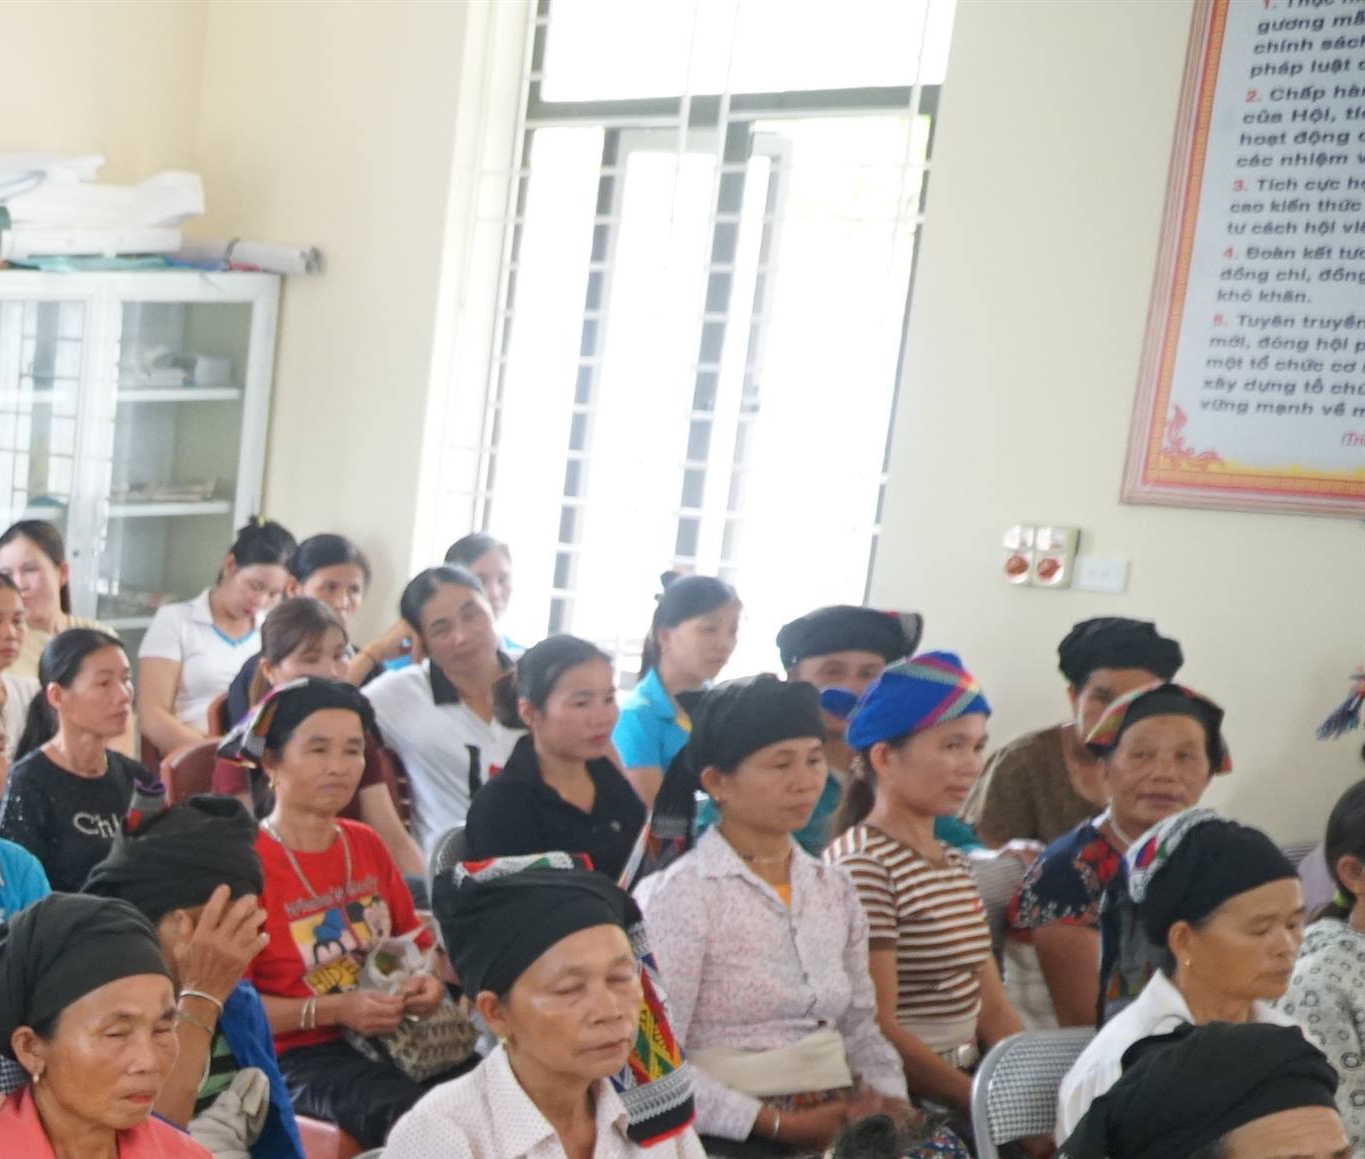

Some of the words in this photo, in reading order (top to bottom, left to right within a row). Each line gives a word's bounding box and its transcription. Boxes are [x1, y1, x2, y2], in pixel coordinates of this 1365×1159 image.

[1257, 18, 1325, 35] gương
[1254, 38, 1313, 54] chính
[1250, 61, 1303, 79] pháp
[1311, 58, 1350, 74] luật
[1245, 89, 1262, 103] 2.
[1270, 85, 1325, 102] Chấp
[1243, 109, 1283, 125] của
[1239, 131, 1286, 147] hoạt
[1293, 130, 1350, 147] động
[1236, 153, 1274, 168] các
[1280, 151, 1349, 168] nhiệm
[1232, 179, 1248, 193] 3.
[1257, 178, 1298, 192] Tích
[1304, 178, 1341, 193] cực
[1230, 201, 1265, 214] cao
[1318, 199, 1362, 213] thức
[1227, 222, 1246, 235] tư
[1251, 221, 1298, 235] cách
[1304, 220, 1337, 236] hội
[1222, 246, 1238, 261] 4.
[1246, 246, 1296, 260] Đoàn
[1302, 245, 1333, 261] kết
[1216, 290, 1253, 303] khó
[1237, 314, 1296, 330] Tuyên
[1316, 337, 1349, 352] hội
[1206, 357, 1244, 371] một
[1275, 358, 1325, 373] chức
[1330, 360, 1357, 373] cơ
[1203, 377, 1237, 393] xây
[1243, 379, 1297, 396] dựng
[1256, 402, 1314, 416] mạnh
